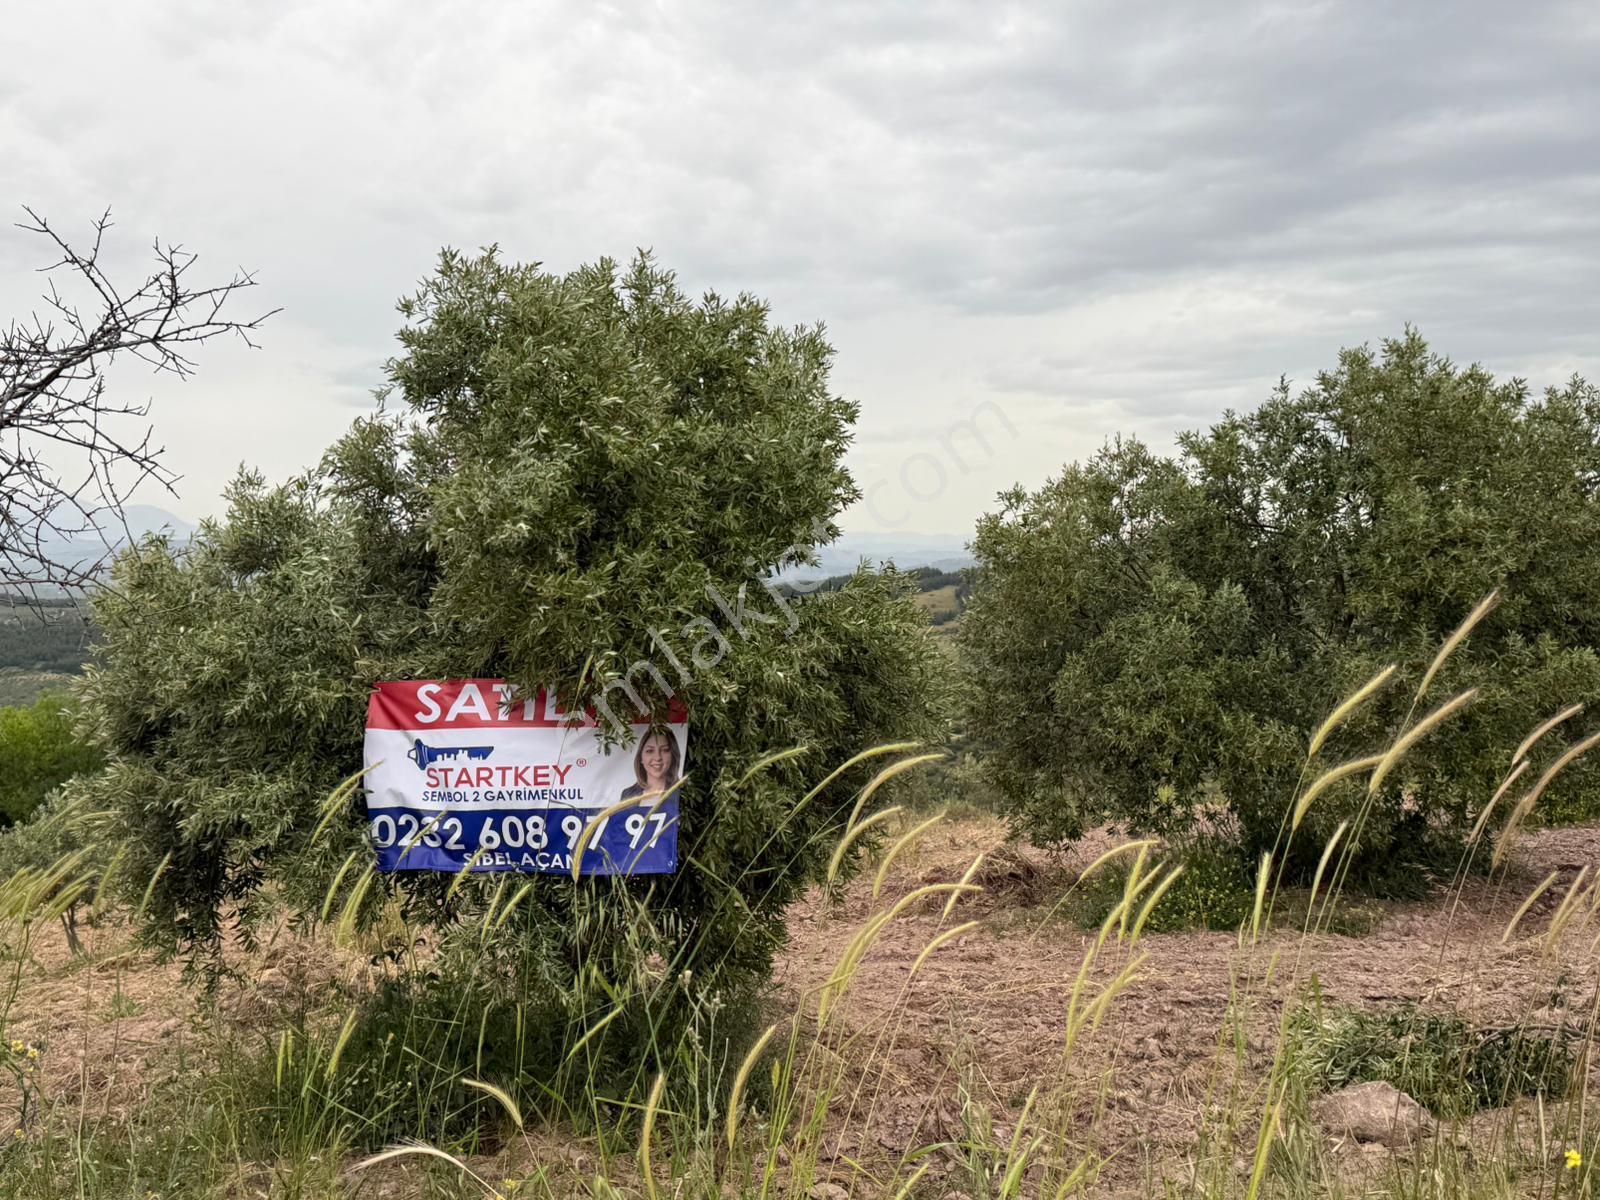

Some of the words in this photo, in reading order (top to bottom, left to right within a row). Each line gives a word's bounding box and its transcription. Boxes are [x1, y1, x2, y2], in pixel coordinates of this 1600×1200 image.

[414, 683, 592, 724] SATIL
[422, 789, 469, 802] SEMBOL
[472, 789, 481, 802] 2
[484, 787, 584, 802] GAYRİMENKUL
[372, 813, 466, 851] 0232
[478, 815, 548, 851] 608
[561, 814, 610, 850] 97
[625, 812, 668, 849] 97
